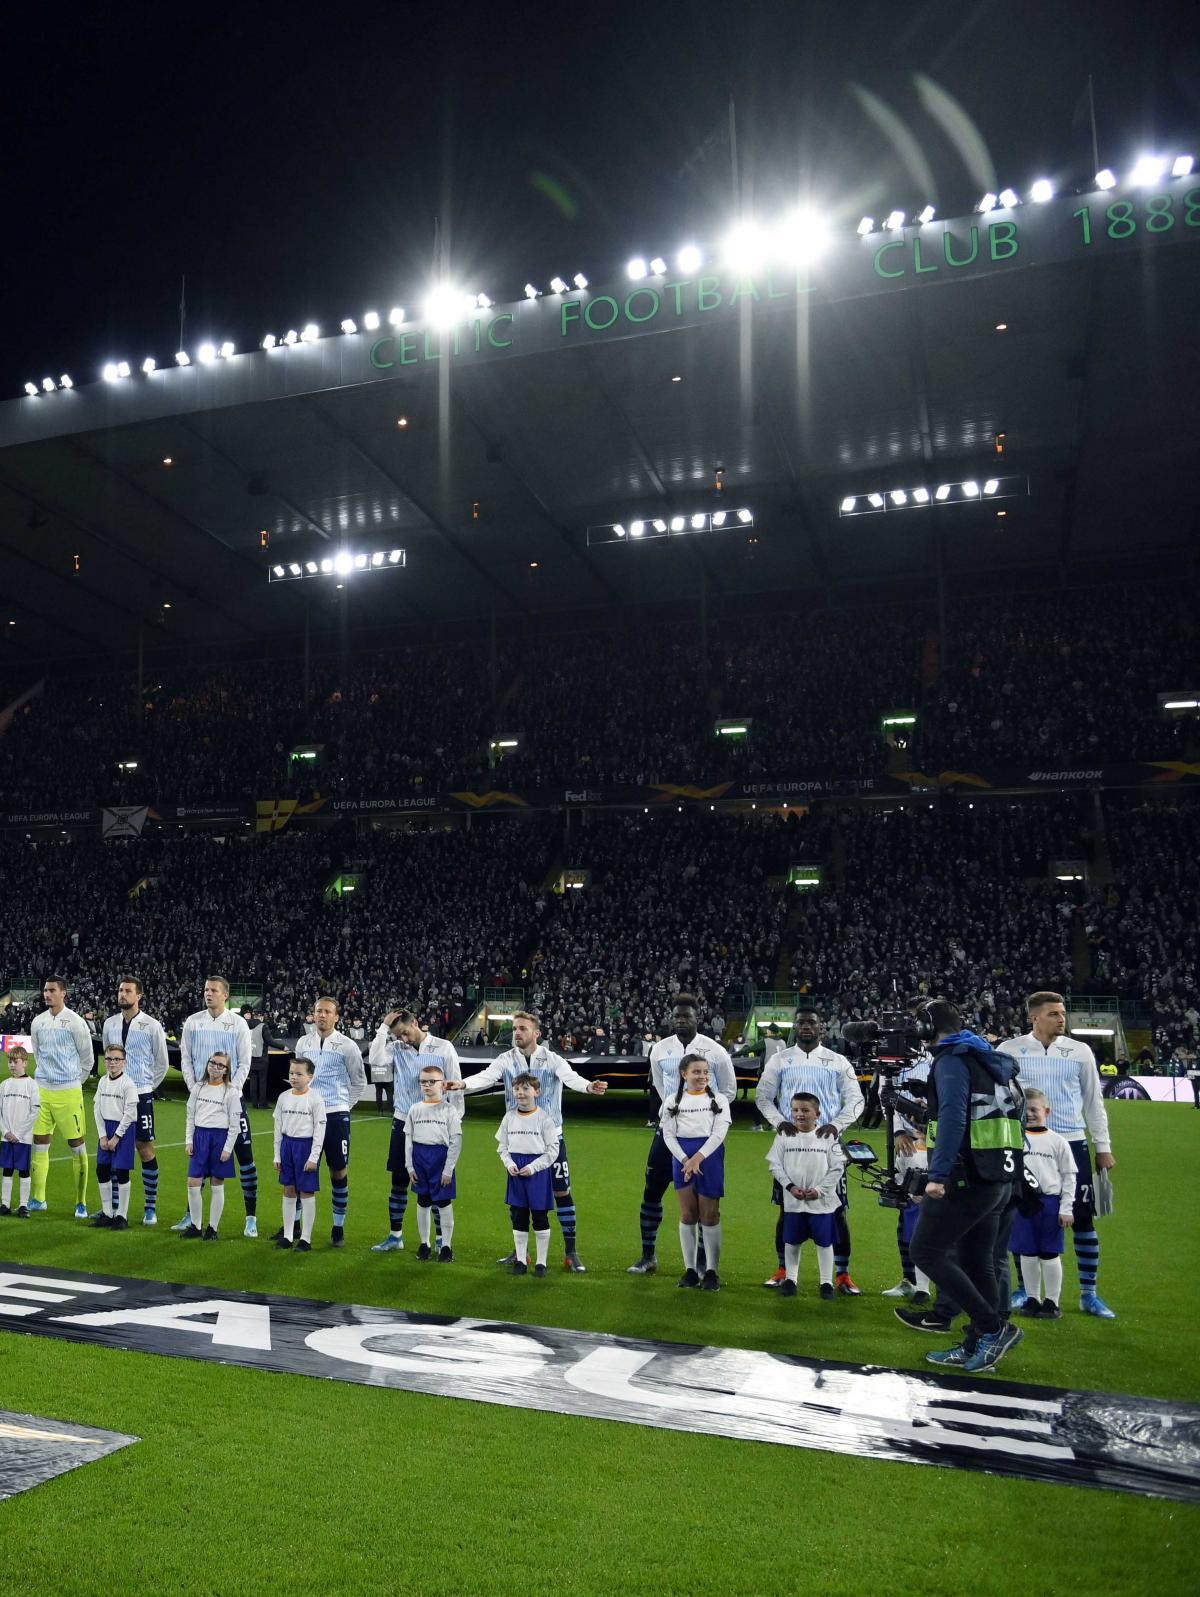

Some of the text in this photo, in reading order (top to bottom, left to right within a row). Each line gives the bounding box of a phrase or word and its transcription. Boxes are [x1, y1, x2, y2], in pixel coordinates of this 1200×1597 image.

[369, 186, 1200, 370] CELTIC FOOTBALL CLUB 1888
[742, 784, 773, 794] UEFA
[776, 781, 822, 792] EUROPA
[333, 797, 437, 810] UEFA EUROPA LEAGUE
[8, 811, 91, 824] UEFA EUROPA LEAGUE
[140, 1114, 153, 1130] 33
[341, 1139, 348, 1155] 6
[1003, 1150, 1015, 1173] 3
[553, 1161, 569, 1179] 29
